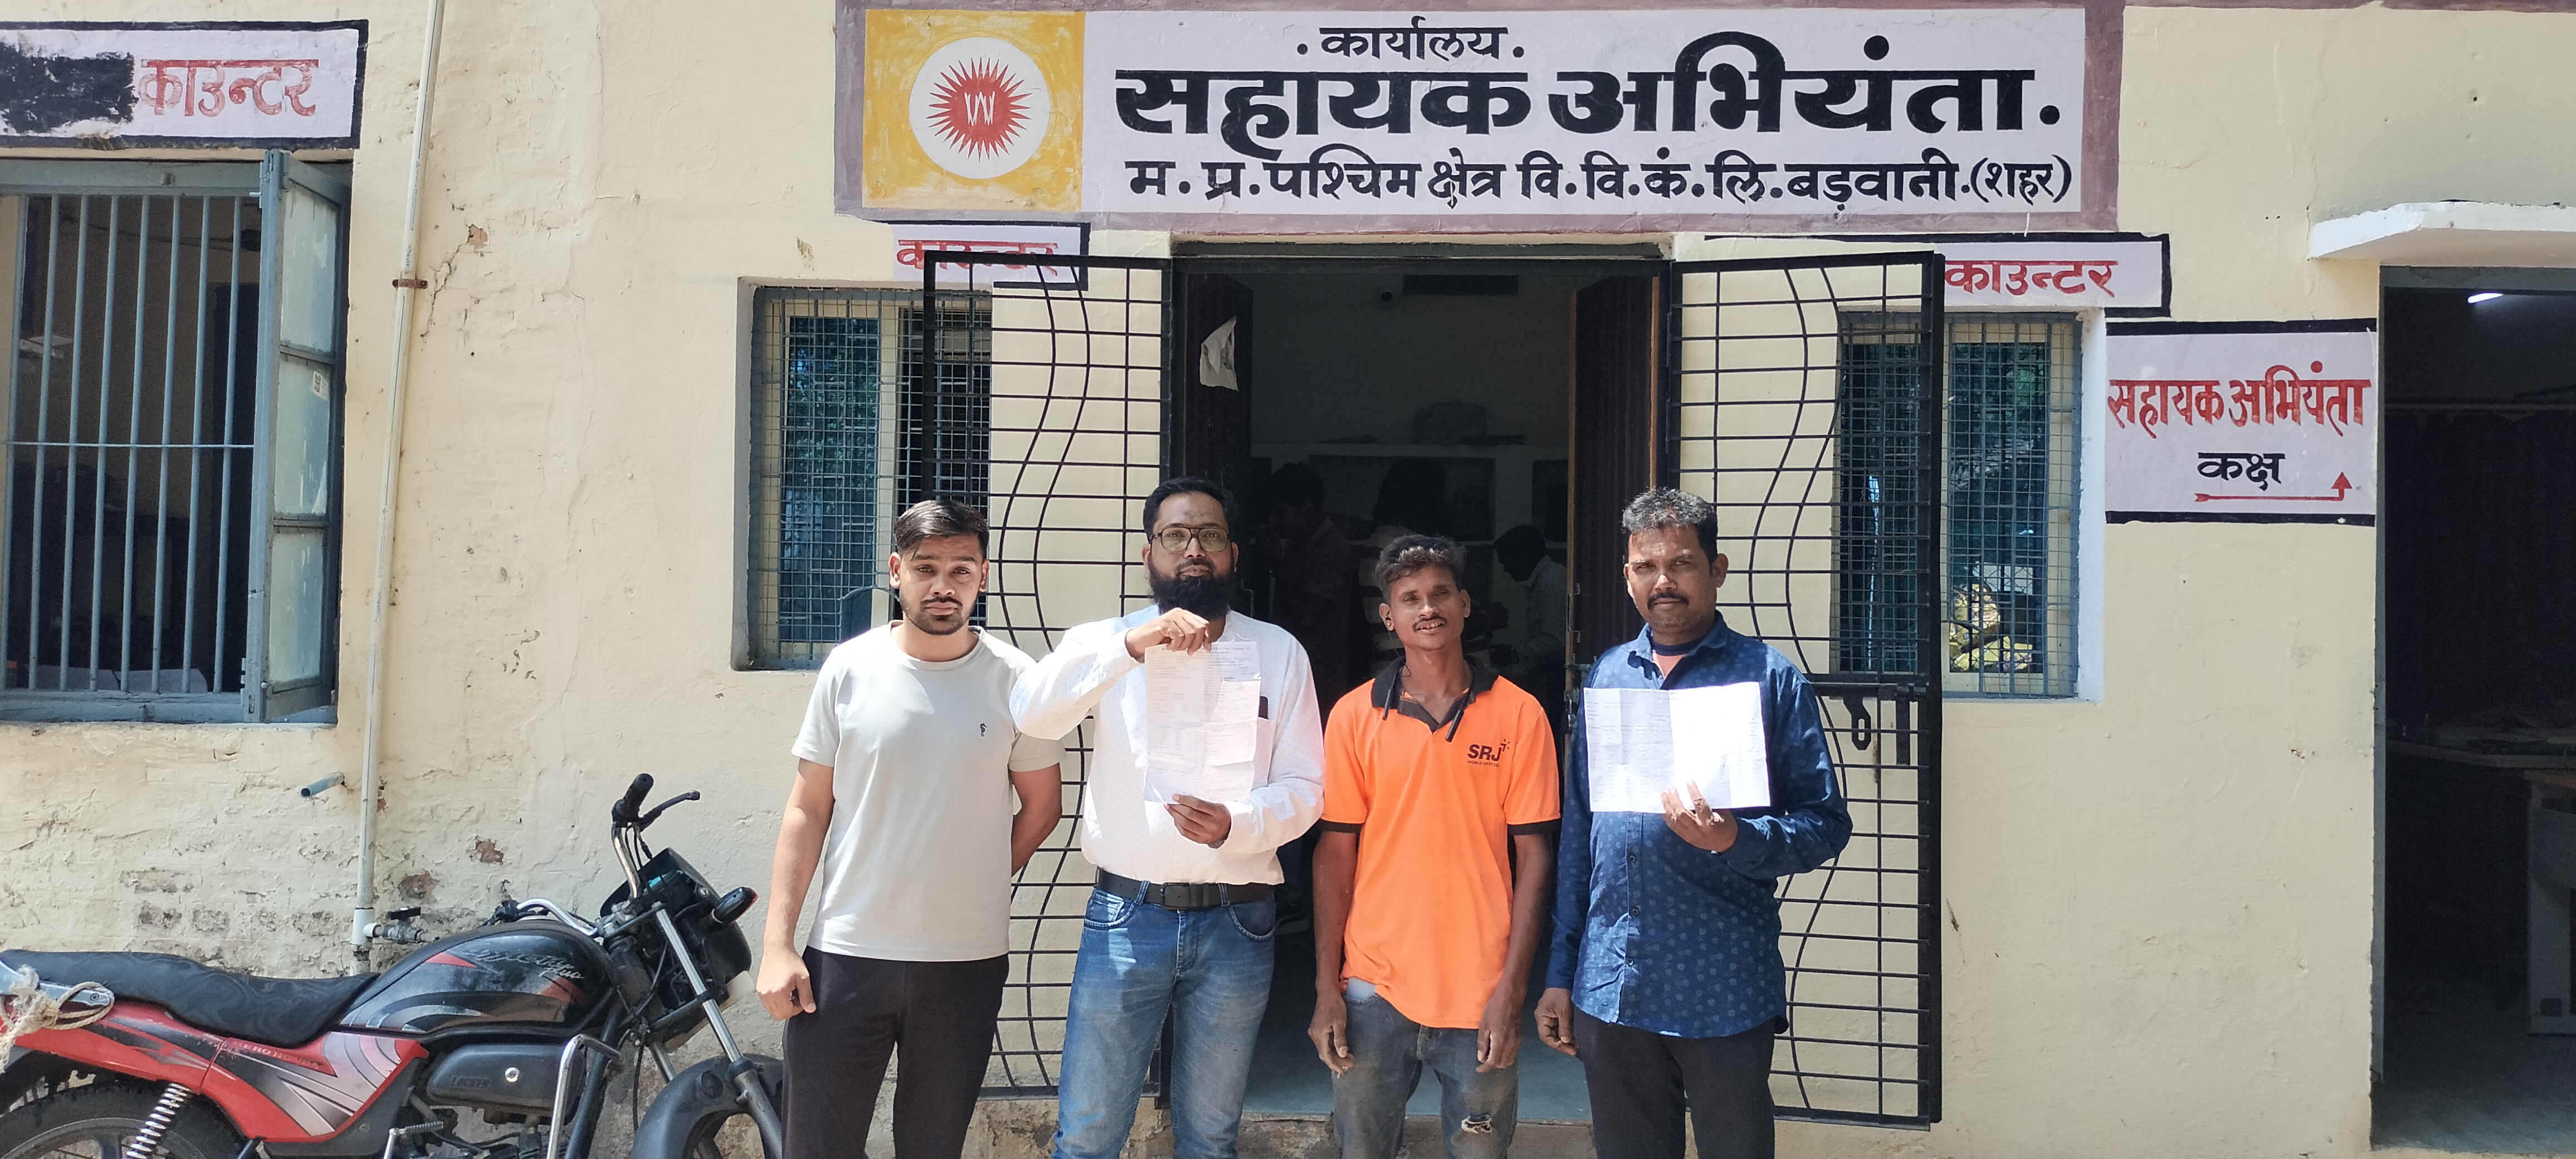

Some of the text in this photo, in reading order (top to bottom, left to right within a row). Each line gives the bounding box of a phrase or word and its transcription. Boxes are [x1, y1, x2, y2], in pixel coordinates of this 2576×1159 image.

[138, 59, 319, 117] काउन्टर
[1115, 70, 1531, 161] सहायक
[1427, 148, 1507, 210] क्षेत्र
[1945, 260, 2118, 298] काउन्टर
[2107, 361, 2372, 439] सहायक अभियंता
[2198, 452, 2285, 491] कक्ष
